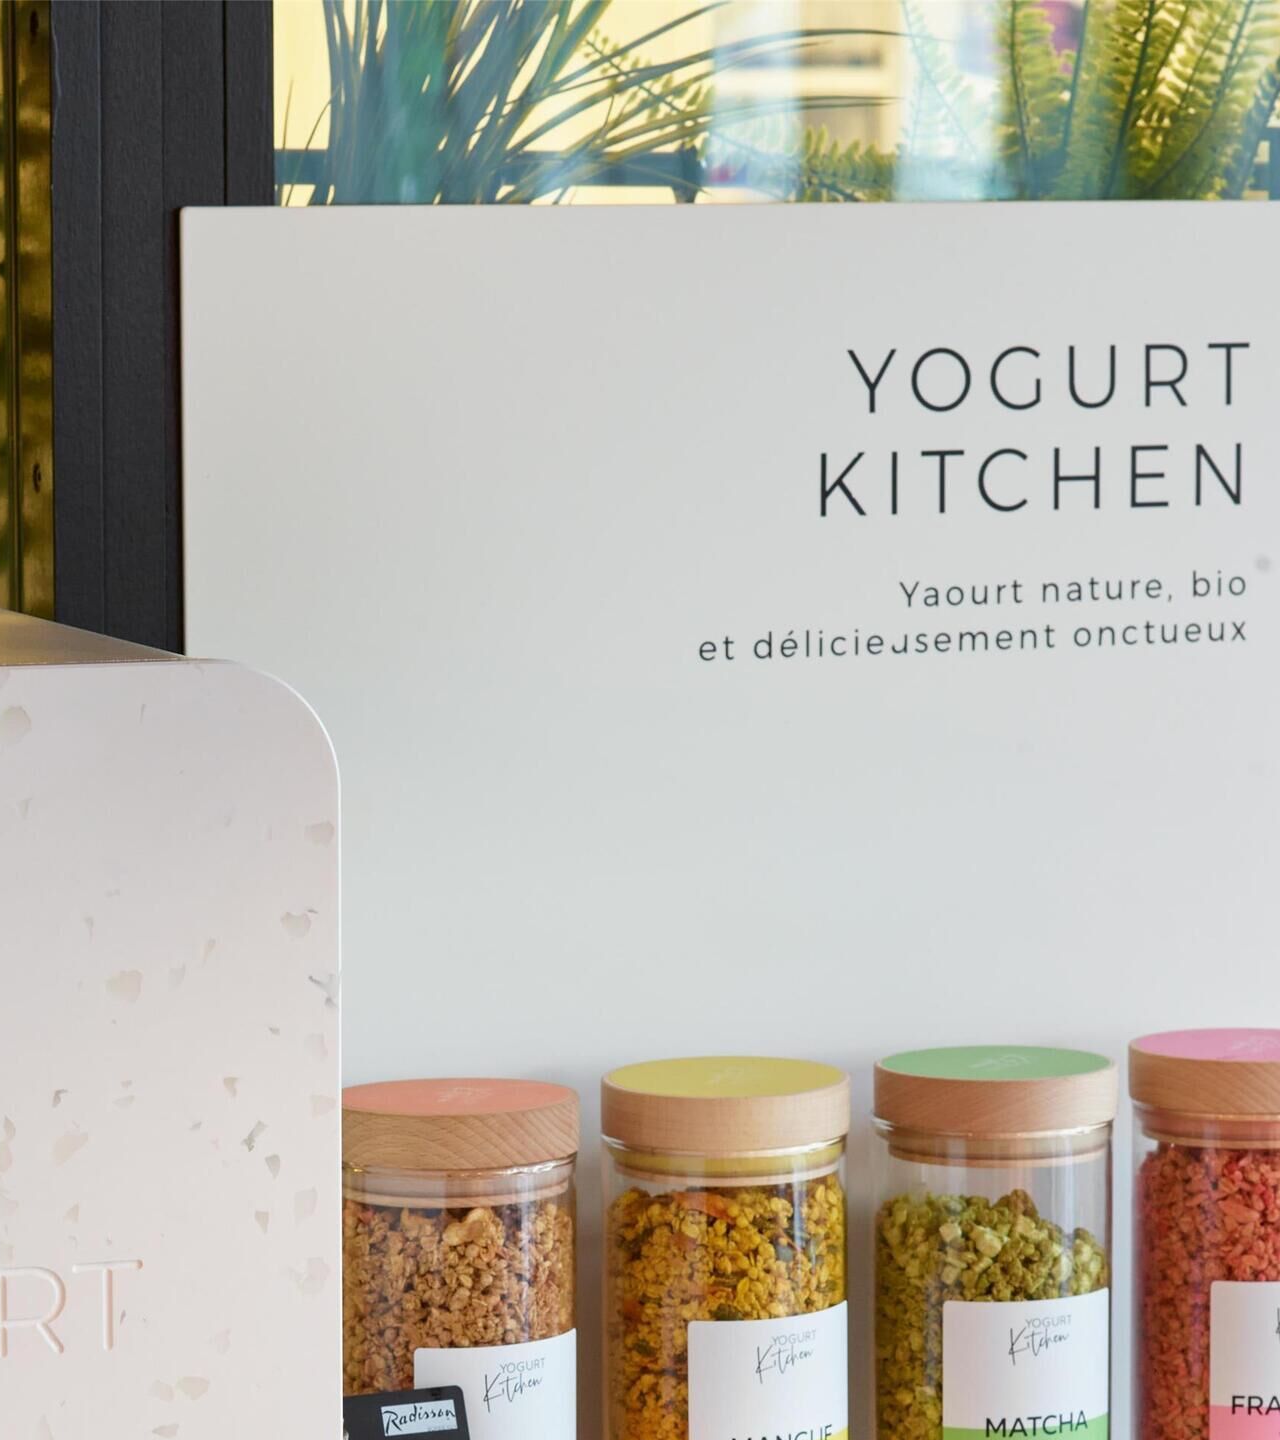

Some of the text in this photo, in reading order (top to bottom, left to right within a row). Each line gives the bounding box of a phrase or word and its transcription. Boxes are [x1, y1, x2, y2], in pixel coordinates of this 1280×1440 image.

[847, 341, 1250, 414] YOGURT
[819, 442, 1243, 517] KITCHEN
[899, 570, 1248, 608] Yaourt nature, bio
[697, 633, 736, 661] et
[1072, 617, 1248, 649] onctueux
[771, 1329, 817, 1347] YOGURT
[1025, 1314, 1072, 1329] YOGURT
[499, 1357, 546, 1374] YOGURT
[755, 1344, 815, 1384] Kitchen
[1008, 1327, 1070, 1366] Kitchen
[483, 1371, 543, 1413] Kitchen
[382, 1404, 458, 1435] Radisson
[985, 1410, 1088, 1438] MATCHA
